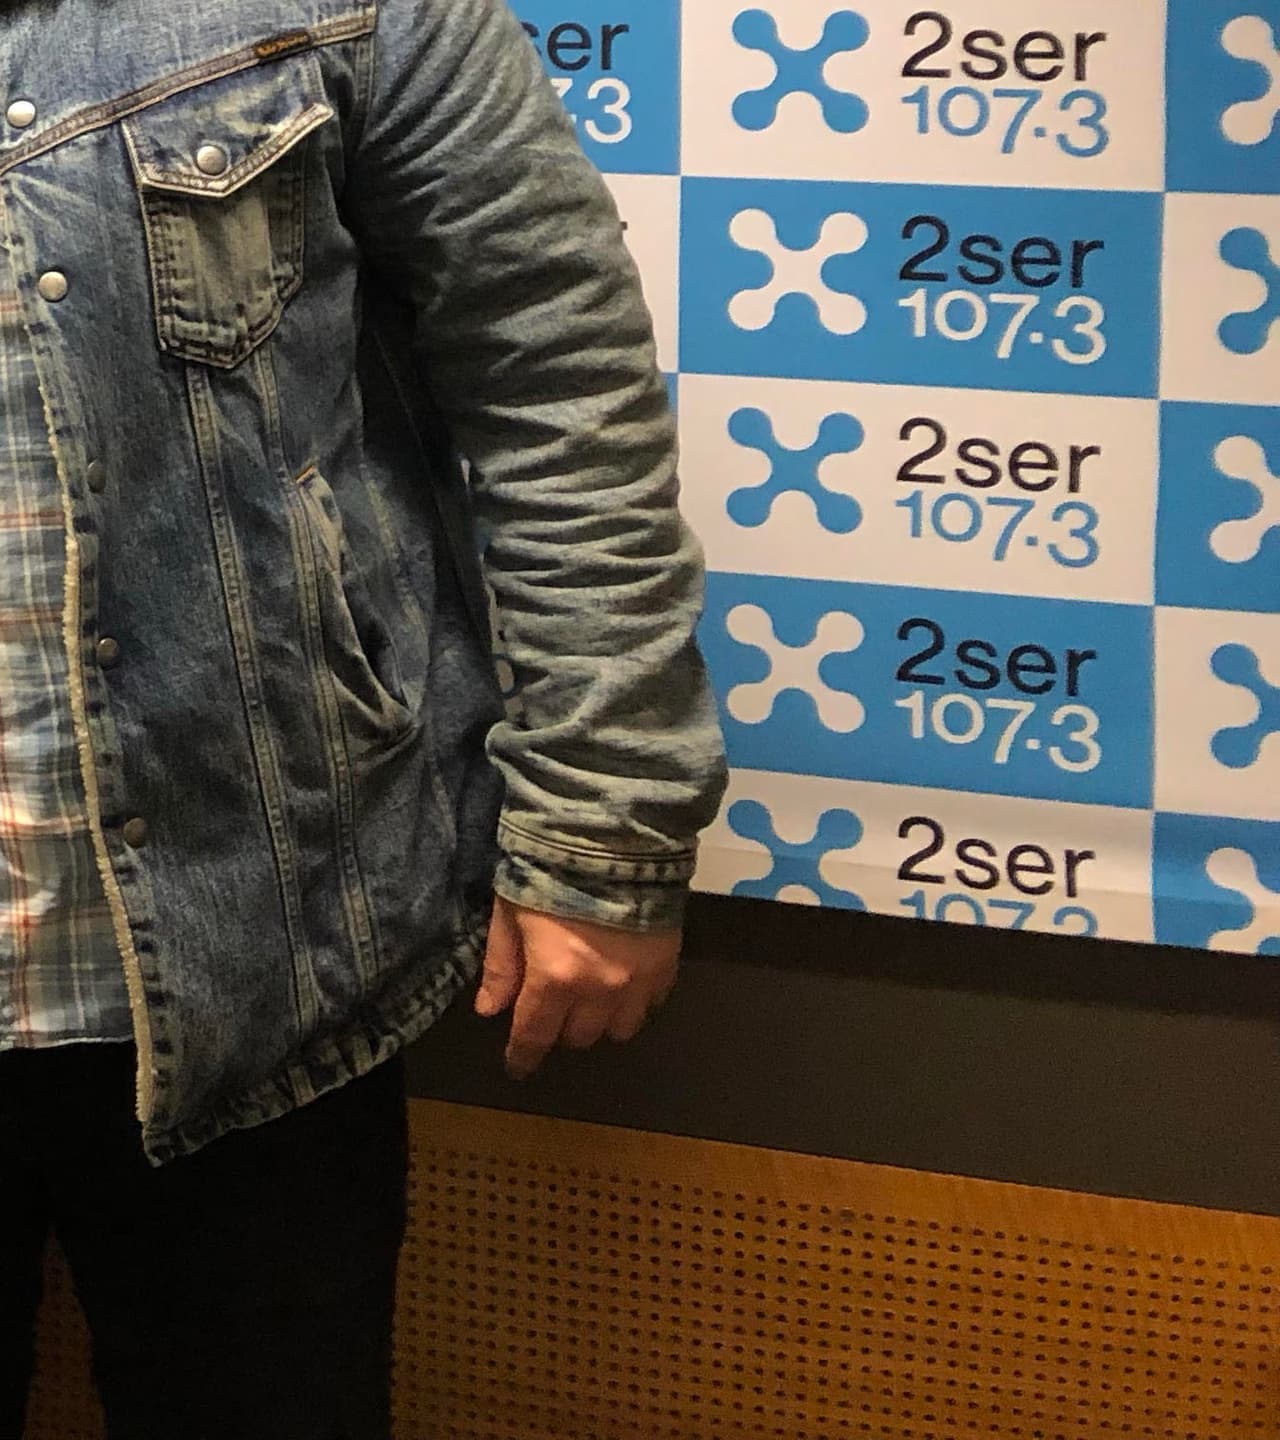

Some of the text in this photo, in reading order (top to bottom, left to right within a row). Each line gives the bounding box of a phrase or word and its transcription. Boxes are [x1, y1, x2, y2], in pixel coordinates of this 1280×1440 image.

[521, 21, 630, 71] er
[901, 11, 1107, 82] 2ser
[901, 86, 1110, 158] 107.3
[899, 215, 1104, 288] 2ser
[898, 289, 1107, 365] 107.3
[896, 417, 1101, 493] 2ser
[895, 490, 1100, 568] 107.3
[895, 617, 1097, 697] 2ser
[895, 691, 1102, 773] 107.3
[897, 816, 1097, 898] 2ser
